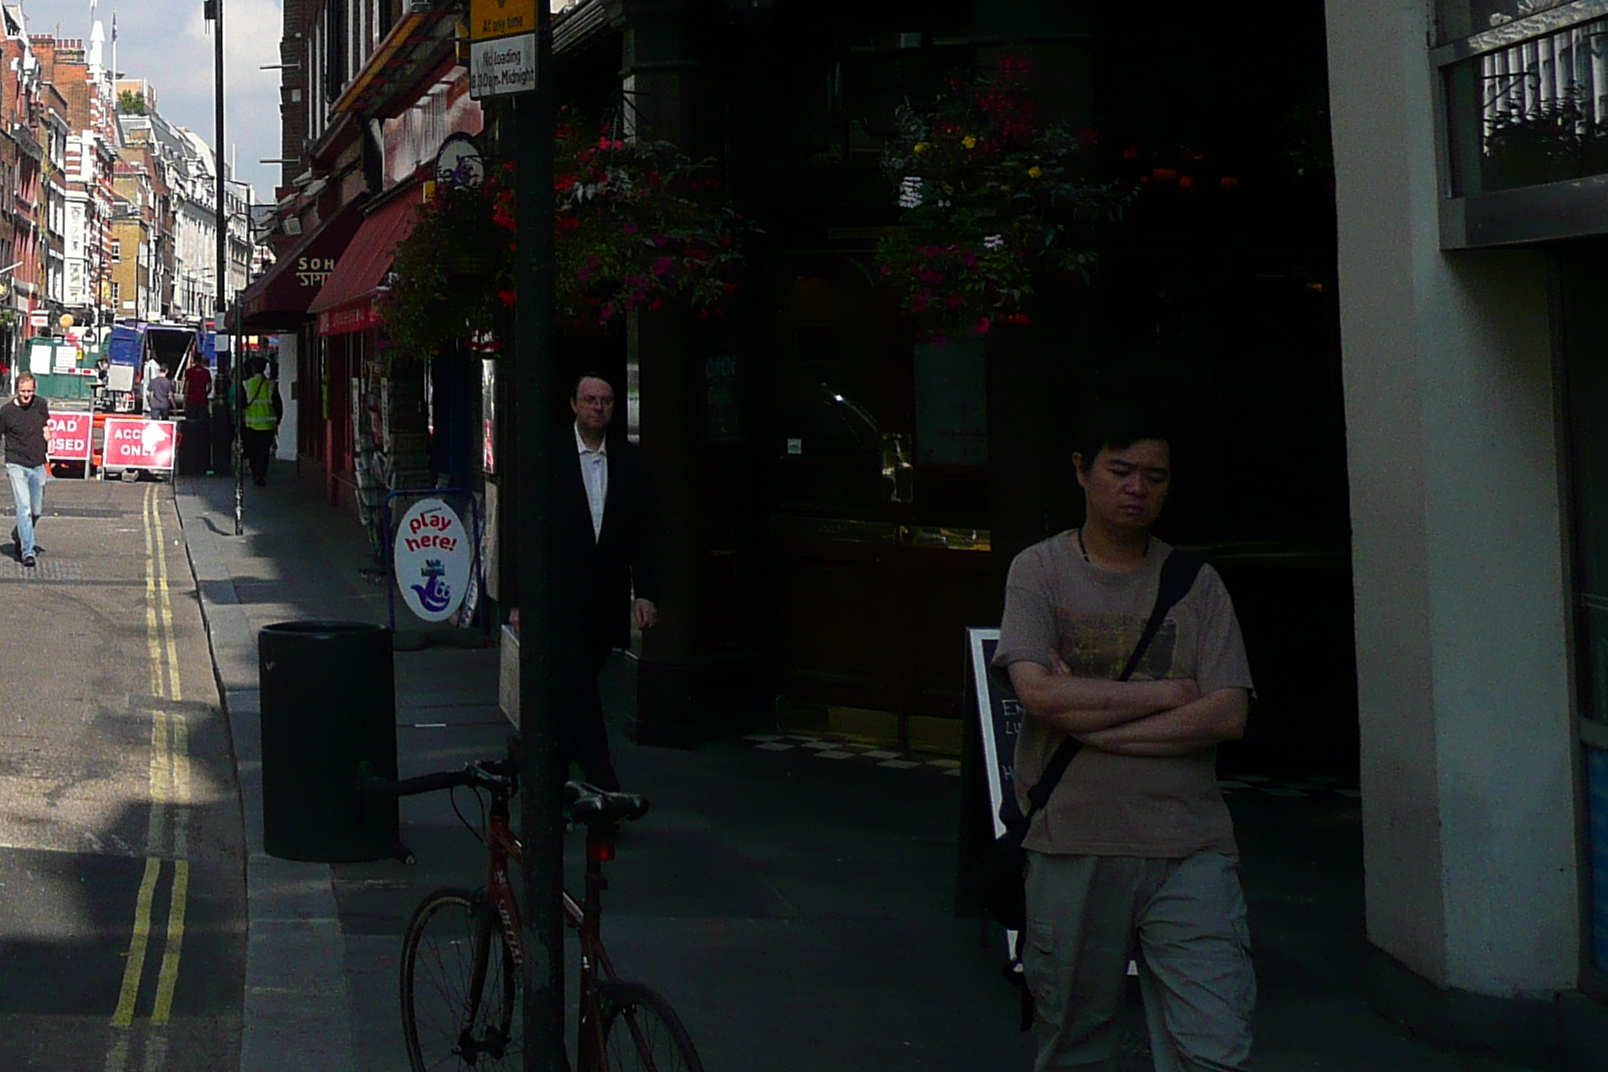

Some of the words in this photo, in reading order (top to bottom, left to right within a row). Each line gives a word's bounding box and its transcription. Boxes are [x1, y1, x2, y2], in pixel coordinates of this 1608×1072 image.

[483, 19, 491, 33] At
[493, 19, 506, 33] any
[507, 15, 524, 29] time
[494, 49, 521, 65] loading
[298, 256, 335, 270] SOH
[47, 419, 78, 432] OAD
[409, 512, 452, 534] play
[405, 535, 457, 552] here!
